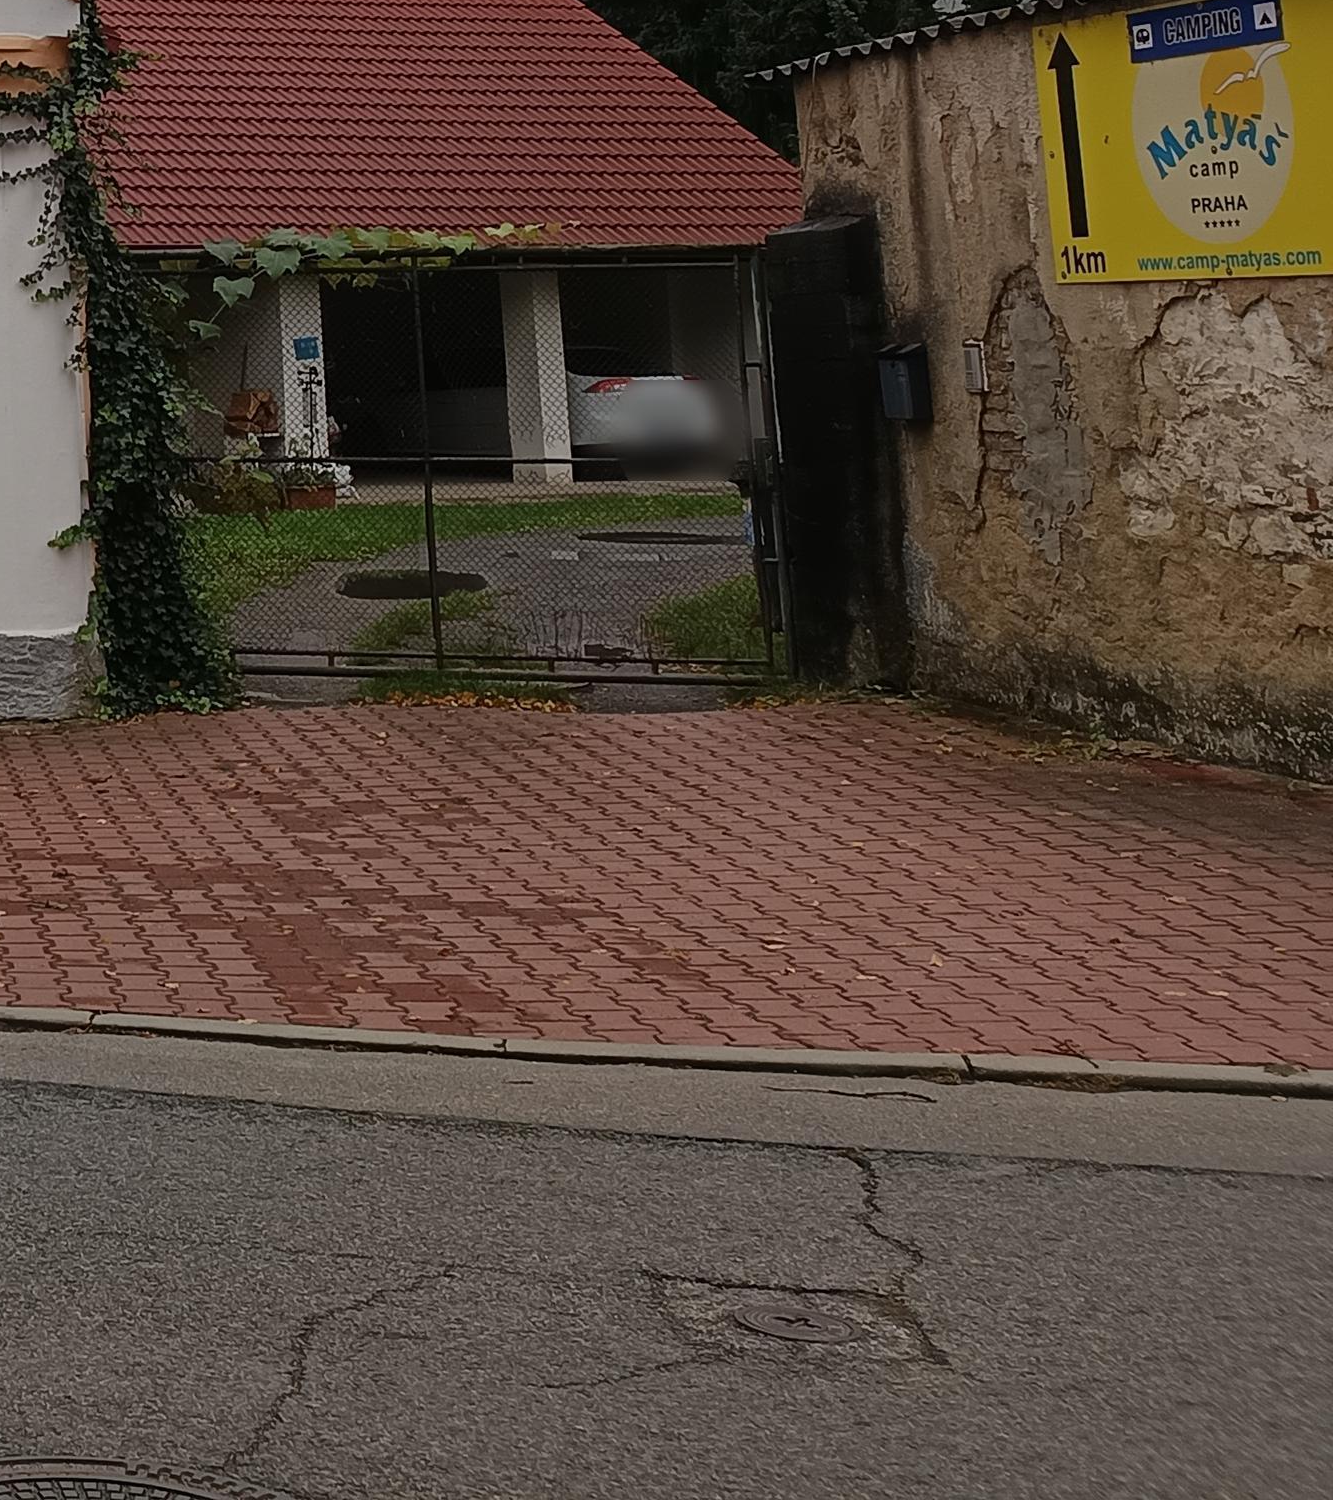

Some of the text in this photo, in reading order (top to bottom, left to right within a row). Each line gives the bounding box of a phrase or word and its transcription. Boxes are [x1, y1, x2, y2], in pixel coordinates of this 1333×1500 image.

[1163, 6, 1242, 46] CAMPING
[1146, 103, 1290, 181] Matyáš
[1189, 160, 1239, 179] camp
[1190, 194, 1249, 213] PRAHA
[1137, 249, 1322, 273] www.camp-matyas.com
